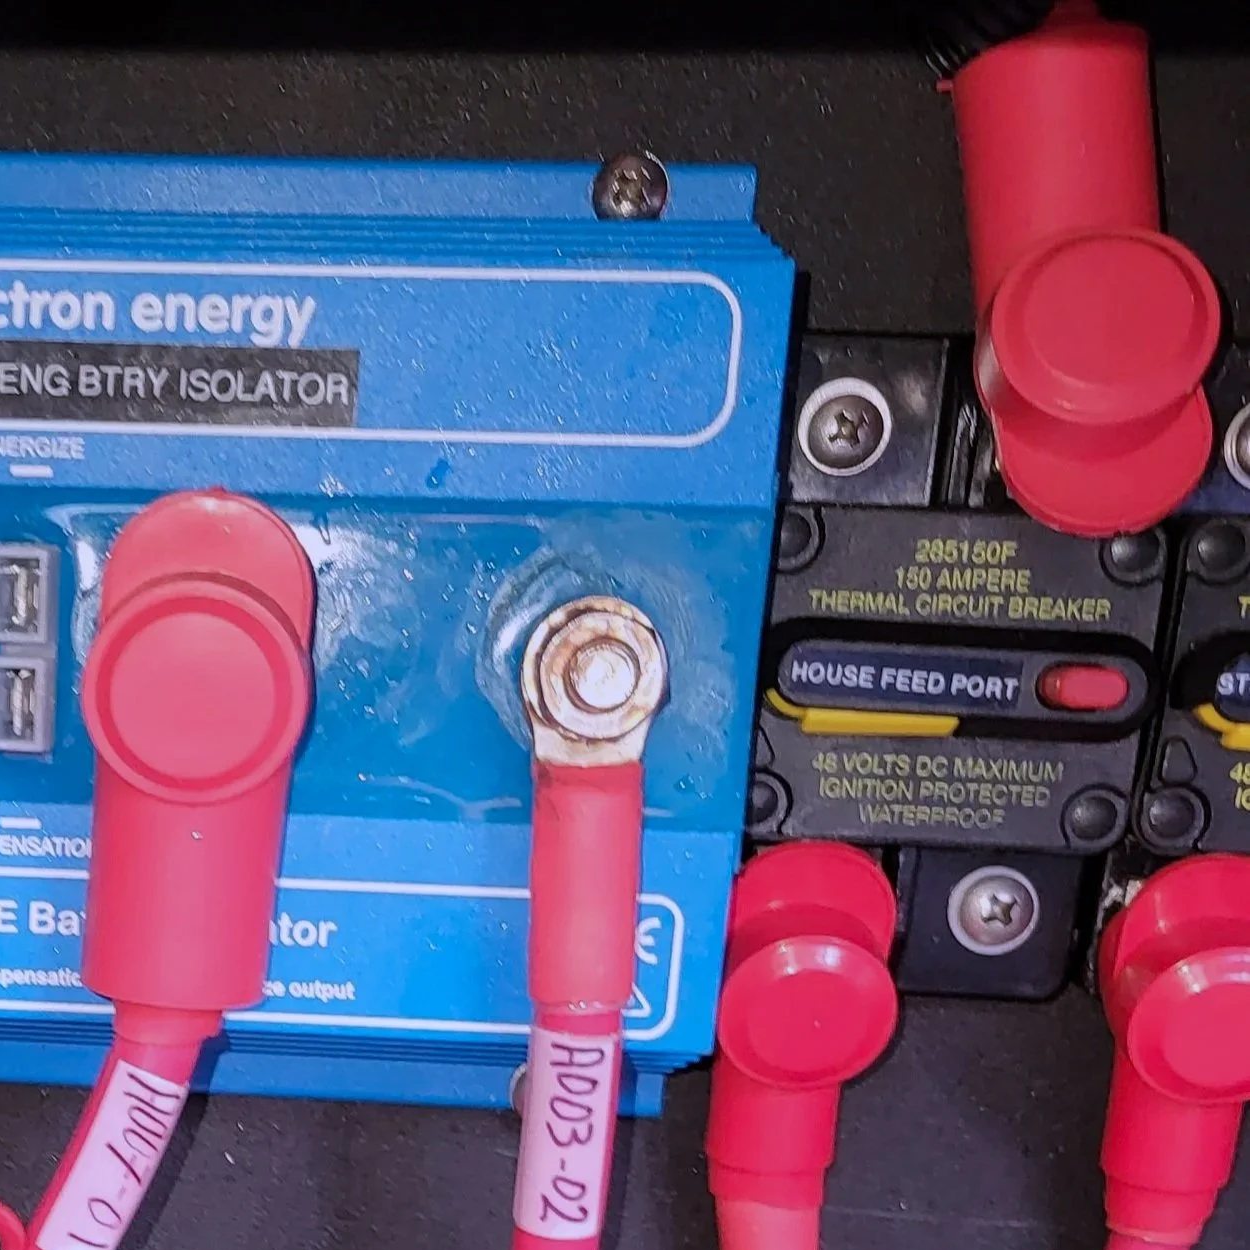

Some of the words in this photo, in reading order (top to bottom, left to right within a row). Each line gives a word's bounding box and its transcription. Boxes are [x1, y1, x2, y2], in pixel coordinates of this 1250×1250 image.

[131, 288, 317, 348] energy
[0, 363, 71, 397] ENG
[78, 366, 169, 400] BTRY
[179, 369, 350, 407] ISOLATOR
[895, 566, 932, 589] 150
[937, 568, 1031, 592] AMPERE
[808, 589, 910, 615] THERMAL
[916, 593, 1004, 618] CIRCUIT
[1008, 596, 1111, 621] BREAKER
[791, 660, 874, 690] HOUSE
[880, 666, 944, 694] FEED
[951, 670, 1020, 701] PORT
[1217, 671, 1250, 697] ST
[813, 752, 838, 774] 48
[843, 752, 911, 777] VOLTS
[916, 756, 949, 778] DC
[954, 758, 1065, 783] MAXIMUM
[819, 776, 913, 800] IGNITION
[918, 781, 1050, 807] PROTECTED
[858, 802, 1005, 828] WATERPROOF
[28, 901, 86, 937] Ba
[289, 980, 356, 1004] output
